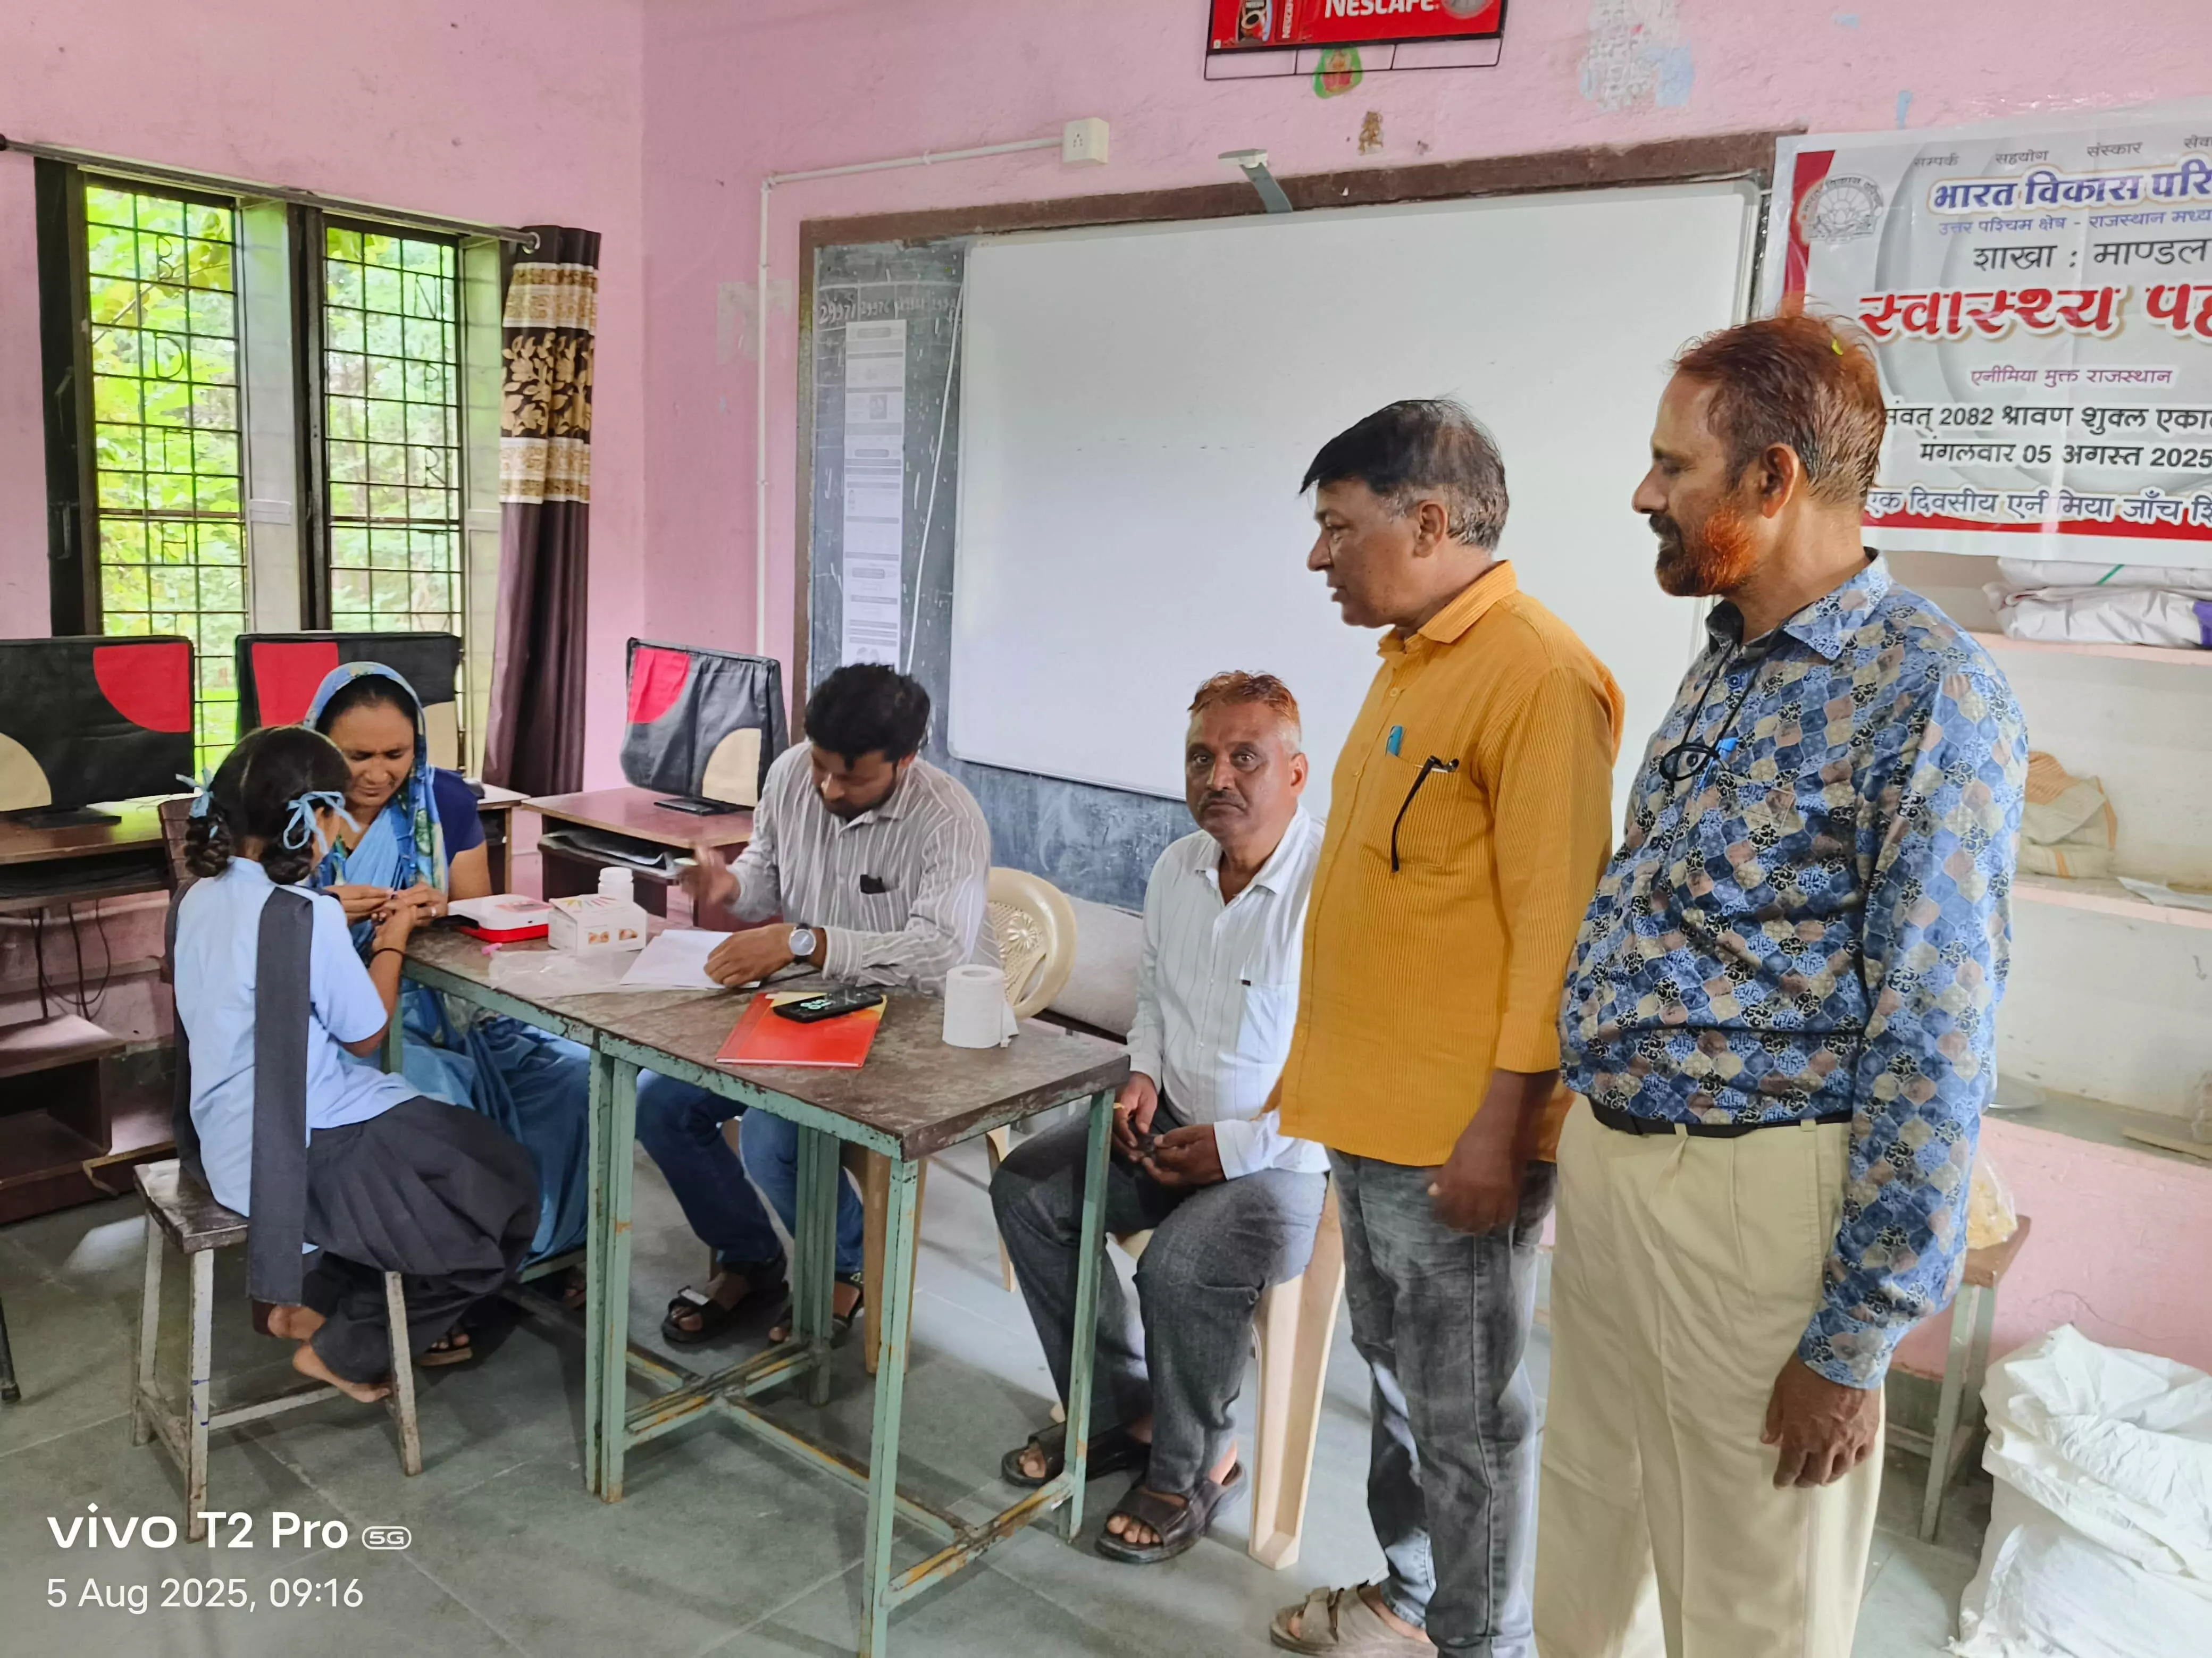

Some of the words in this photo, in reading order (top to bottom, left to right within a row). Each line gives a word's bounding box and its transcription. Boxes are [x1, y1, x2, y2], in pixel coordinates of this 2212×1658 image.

[2087, 142, 2143, 157] संस्कार
[1934, 183, 2018, 208] भारत
[2025, 170, 2144, 204] विकास
[2089, 212, 2166, 228] राजस्थान
[1973, 245, 2058, 271] शाखा
[1859, 287, 2121, 336] स्वास्थ्य
[1971, 365, 2038, 386] एनीमिया
[2044, 369, 2080, 388] मुक्त
[2087, 369, 2173, 383] राजस्थान
[1940, 407, 1993, 426] 2082
[2001, 405, 2074, 426] श्रावण
[2081, 407, 2149, 435] शुक्ल
[2156, 408, 2212, 433] एका
[1920, 435, 2016, 462] मंगलवार
[2023, 444, 2051, 464] 05
[2063, 445, 2144, 466] अगस्त
[2150, 448, 2212, 468] 2025
[1909, 486, 1999, 512] दिवसीय
[2123, 490, 2183, 520] जाँच
